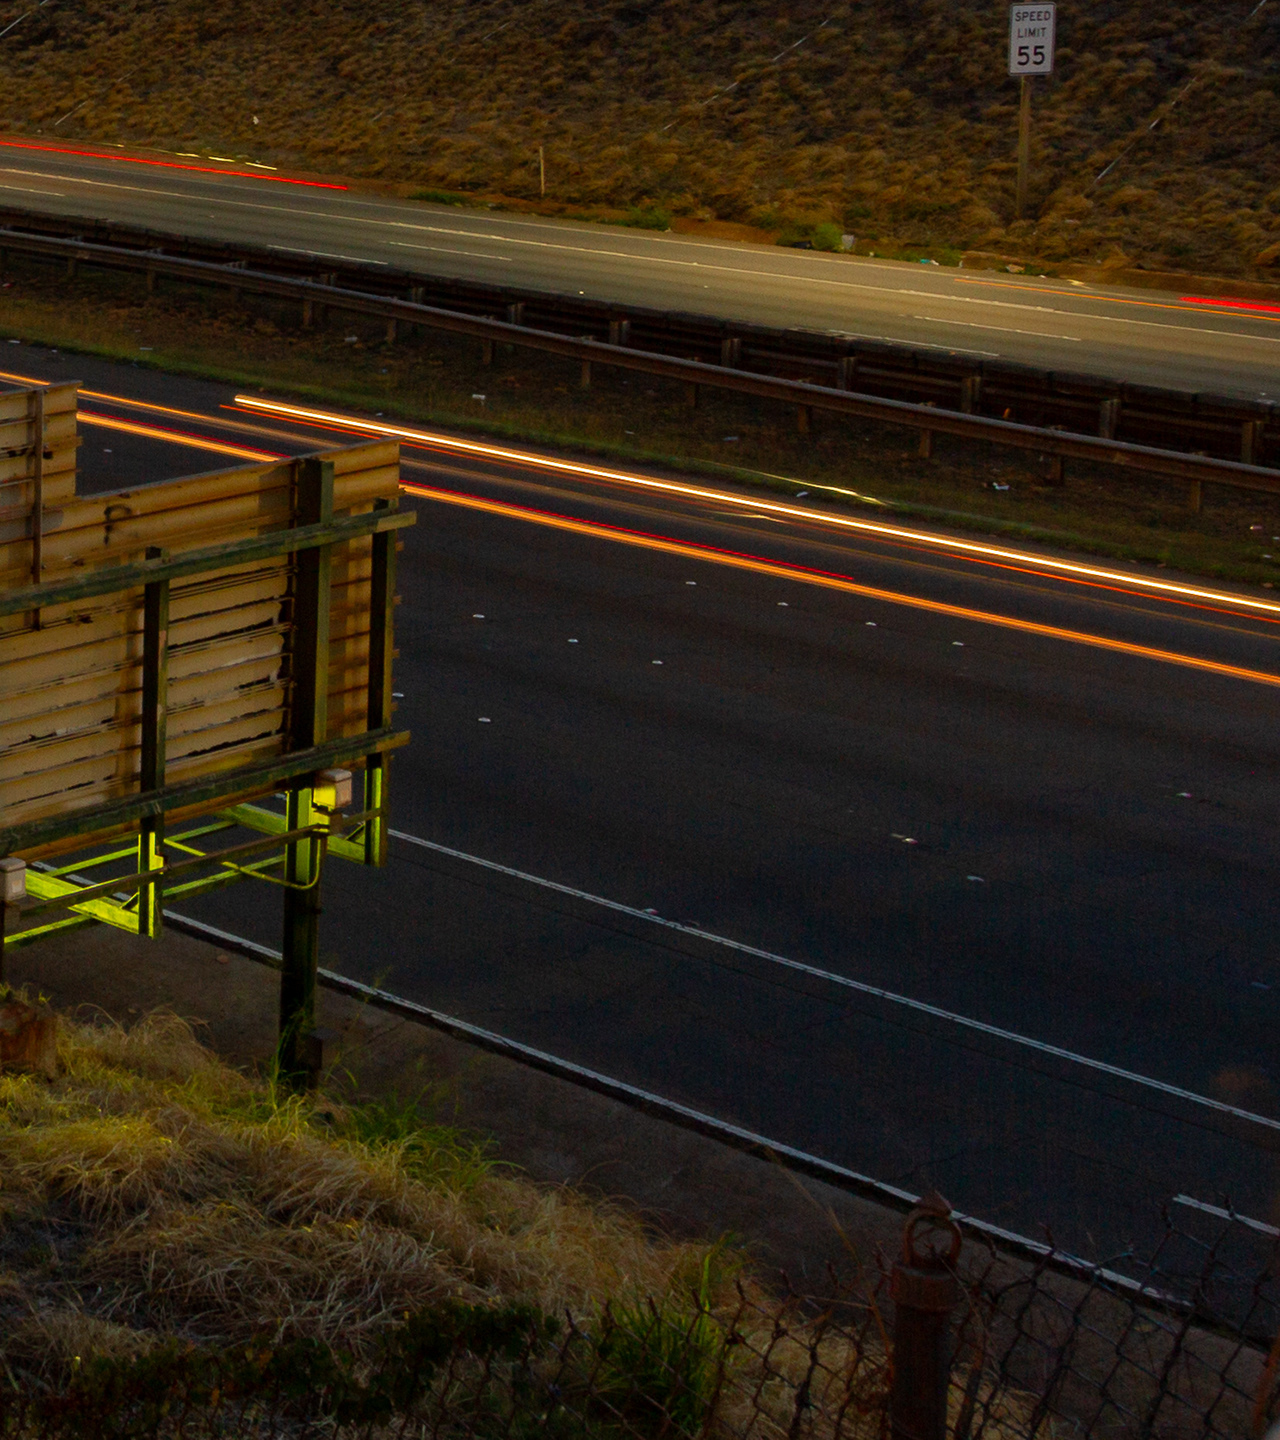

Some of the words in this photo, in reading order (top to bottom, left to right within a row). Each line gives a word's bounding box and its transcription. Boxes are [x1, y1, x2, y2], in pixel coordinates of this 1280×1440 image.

[1015, 11, 1051, 22] SPEED
[1017, 28, 1047, 38] LIMIT
[1017, 46, 1045, 66] 55
